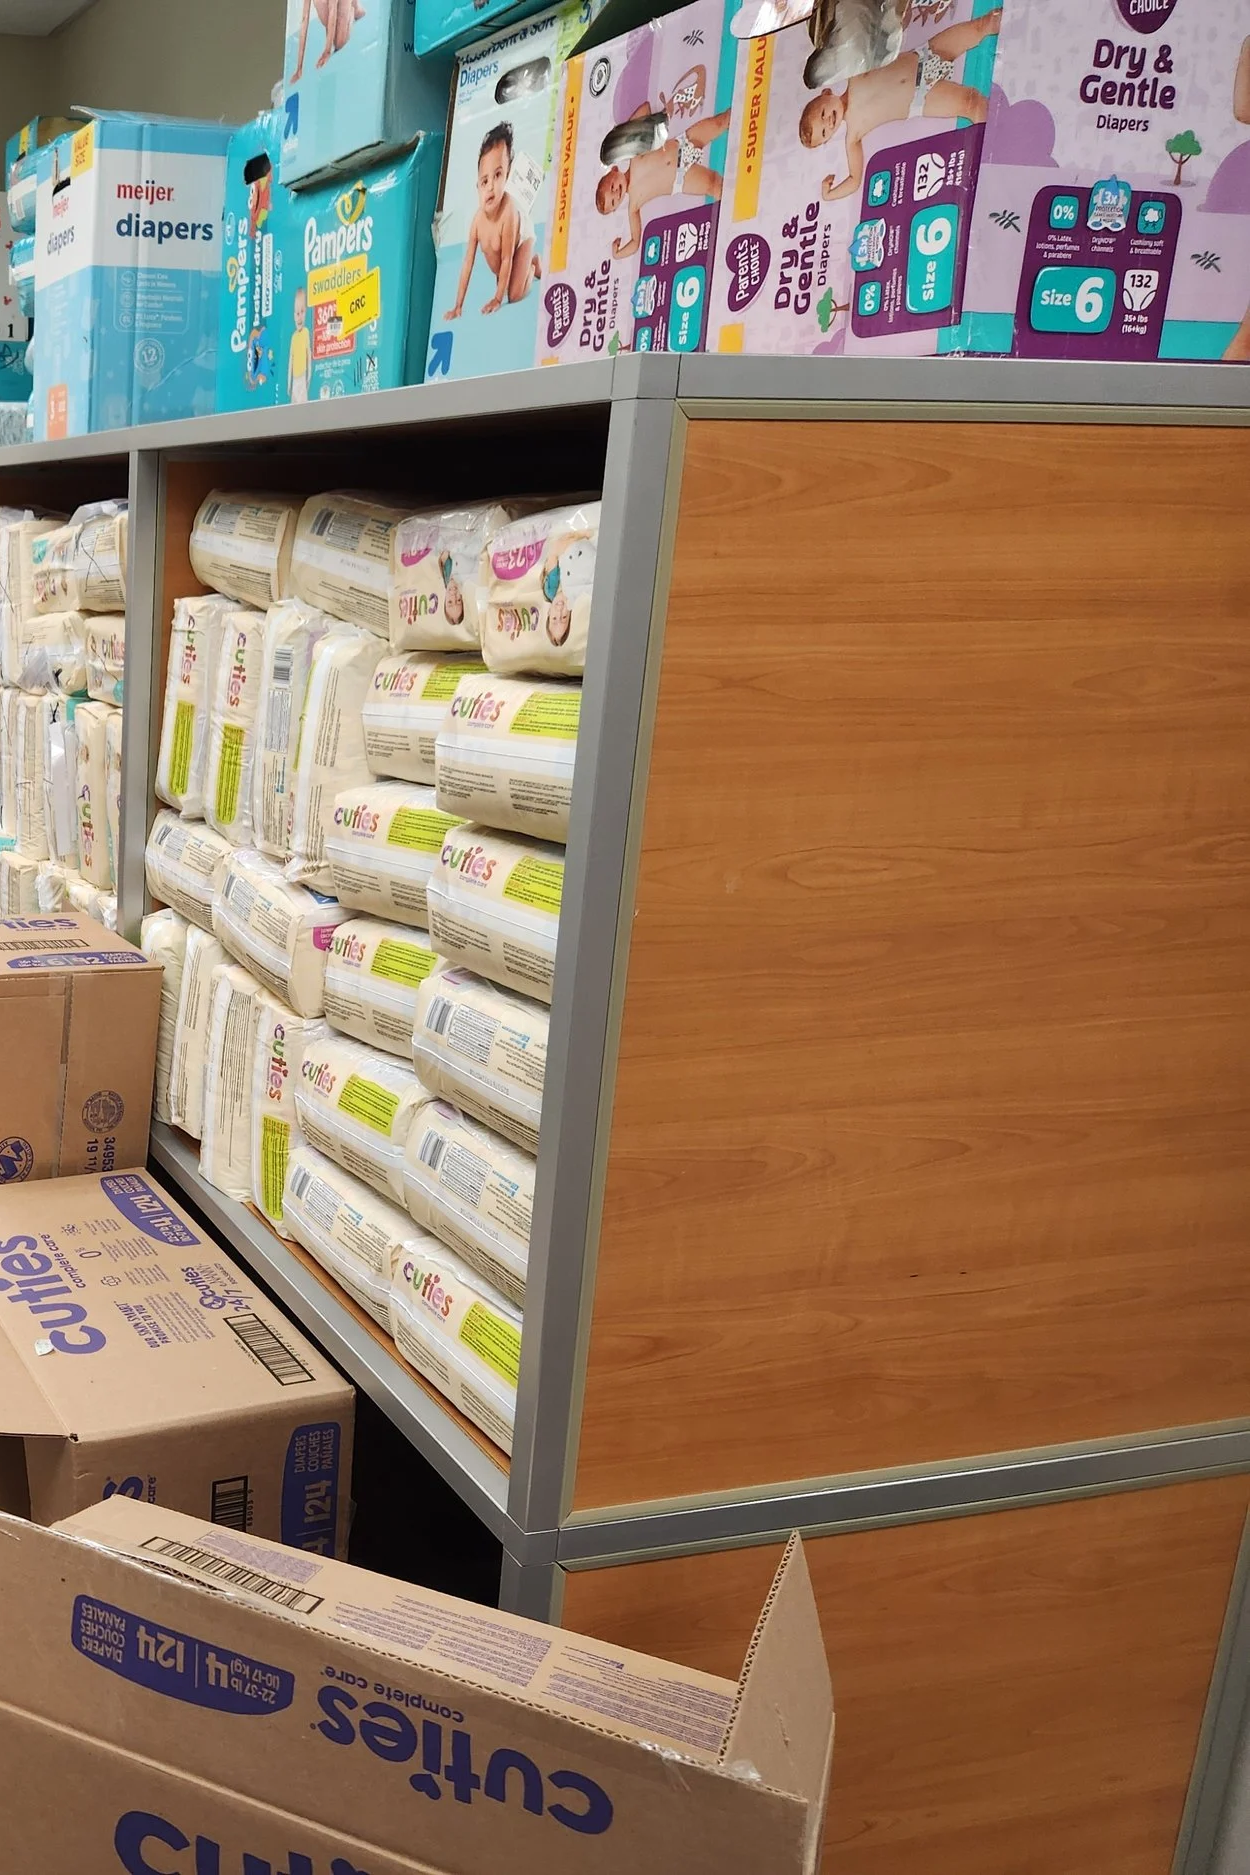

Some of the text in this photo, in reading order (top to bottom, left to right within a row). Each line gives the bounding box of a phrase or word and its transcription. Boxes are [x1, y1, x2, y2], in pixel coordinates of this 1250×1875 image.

[459, 60, 500, 88] Diapers
[1093, 39, 1174, 79] Dry &
[746, 34, 767, 159] SUPER VALU
[1080, 74, 1176, 110] Gentle
[1096, 114, 1149, 133] Diapers
[559, 107, 575, 220] SUPER VALUE
[917, 162, 929, 193] 132
[117, 180, 174, 205] meijer
[1103, 191, 1118, 205] 3x
[116, 213, 214, 245] diapers
[1053, 205, 1075, 221] 0%
[47, 226, 75, 256] diapers
[304, 216, 374, 273] Pampers
[678, 230, 688, 256] 132
[794, 200, 821, 316] Gentle
[817, 223, 832, 287] Diapers
[736, 238, 750, 304] Parent's
[749, 243, 760, 288] CHOICE
[774, 214, 800, 310] Dry &
[916, 217, 952, 301] Size 6
[231, 216, 251, 353] Pampers
[312, 266, 363, 296] swaddlers
[864, 285, 876, 311] 0%
[1130, 274, 1152, 289] 132
[349, 295, 367, 314] CRC
[552, 287, 563, 340] Parent's
[562, 289, 571, 328] CHOICE
[579, 269, 597, 347] Dry &
[593, 259, 612, 352] Gentle
[609, 278, 620, 329] Diapers
[676, 276, 701, 346] Size 6
[1040, 276, 1105, 323] Size 6
[7, 323, 15, 338] 1
[1123, 314, 1148, 324] 35+ lbs
[497, 606, 540, 641] cuties
[230, 632, 247, 707] cuties
[374, 667, 418, 692] cuties
[451, 691, 506, 723] cuties
[334, 804, 380, 833] cuties
[441, 844, 498, 883] cuties
[269, 1023, 289, 1103] cuties
[302, 1060, 336, 1093] cuties
[86, 1138, 99, 1153] 19
[130, 1194, 164, 1213] 124
[40, 1234, 87, 1289] complete care
[181, 1266, 216, 1299] cuties
[403, 1261, 453, 1317] cuties
[222, 1289, 254, 1313] 24/7
[148, 1322, 172, 1345] PROMISE
[295, 1435, 308, 1474] DIAPERS
[307, 1430, 321, 1473] COUCHES
[147, 1476, 157, 1504] care
[303, 1480, 332, 1524] 124
[80, 1619, 125, 1648] COUCHES
[81, 1636, 123, 1664] DIAPERS
[136, 1625, 229, 1689] 4 124
[230, 1658, 280, 1691] (10-17 kg)
[231, 1677, 276, 1705] 22-37 lb
[323, 1664, 465, 1723] complete care
[316, 1683, 614, 1836] cuties
